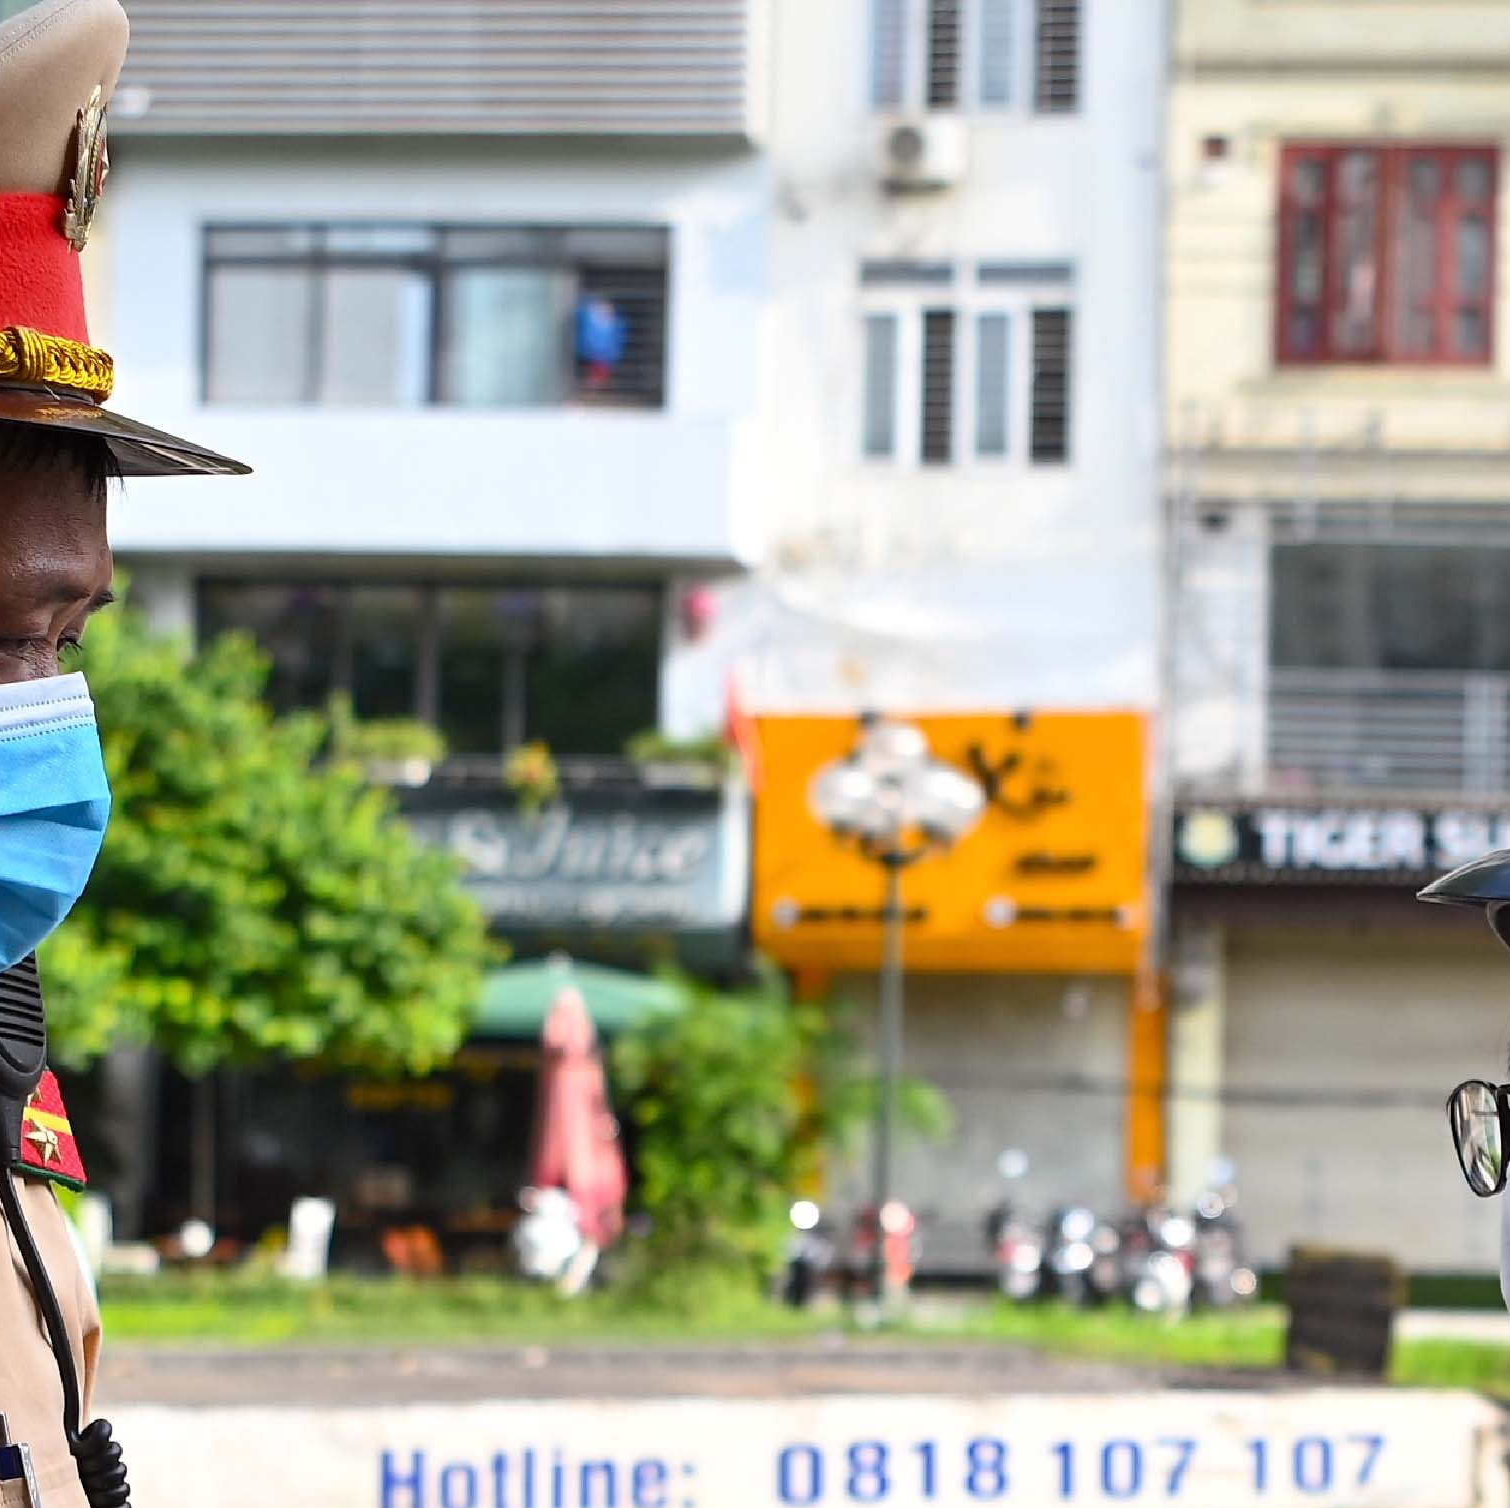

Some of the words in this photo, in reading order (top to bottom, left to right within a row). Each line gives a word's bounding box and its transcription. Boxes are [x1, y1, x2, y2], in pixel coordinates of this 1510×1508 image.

[1257, 808, 1424, 870] TIGER
[776, 1437, 1010, 1506] 0818
[1051, 1436, 1199, 1499] 107
[1246, 1434, 1386, 1493] 107
